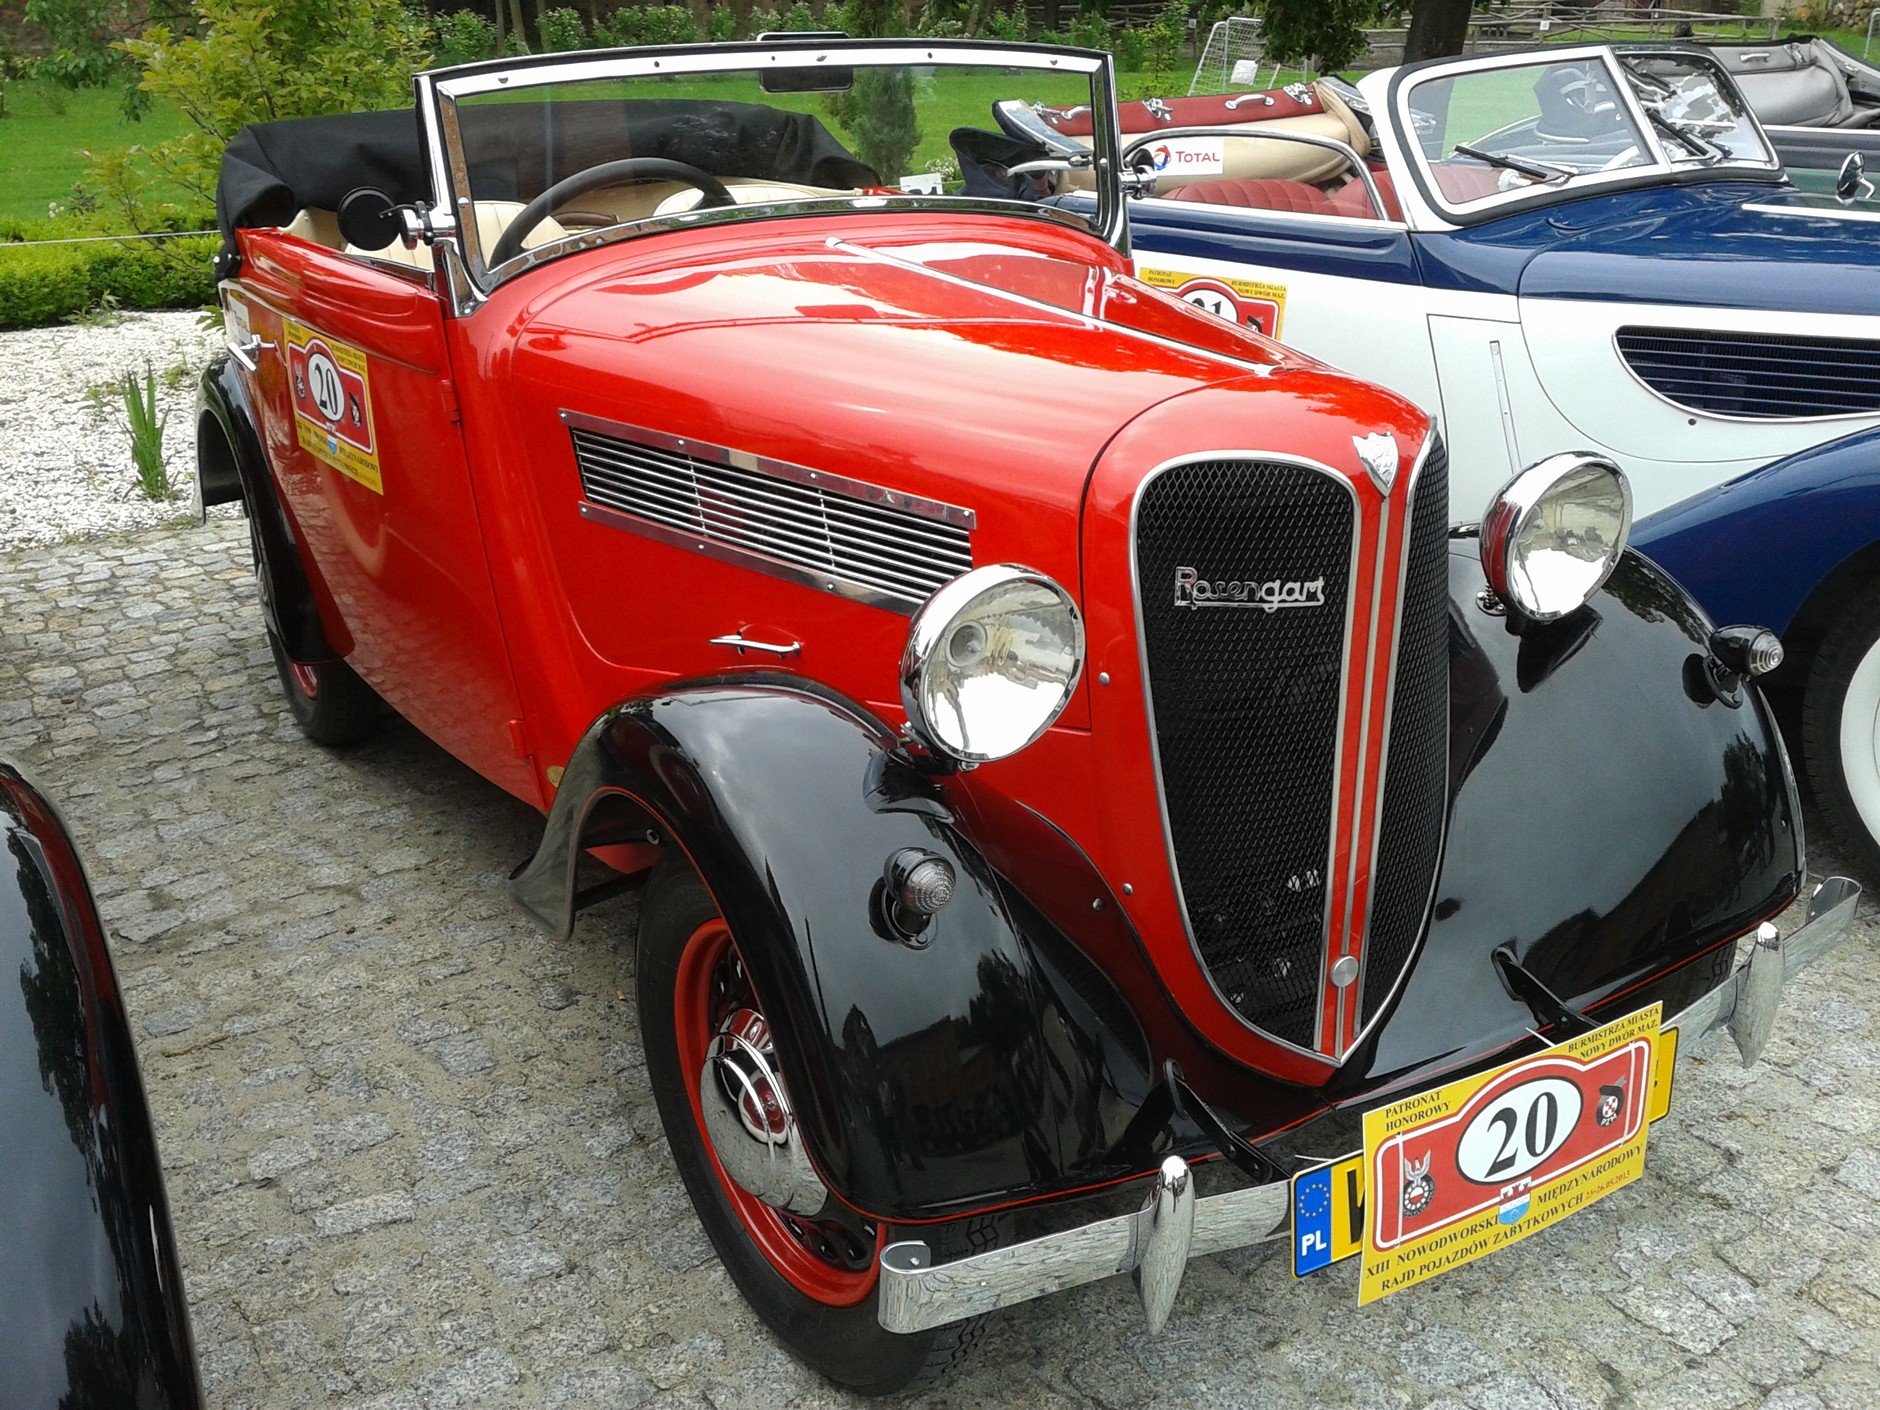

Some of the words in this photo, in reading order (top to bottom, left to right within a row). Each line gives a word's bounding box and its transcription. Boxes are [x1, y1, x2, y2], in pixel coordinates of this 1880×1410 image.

[314, 362, 338, 416] 20
[1174, 566, 1325, 613] Rosengart
[1567, 1023, 1626, 1053] BURMISTRZA
[1627, 1007, 1660, 1027] MIASTA
[1580, 1040, 1609, 1059] NOWY
[1608, 1029, 1635, 1047] DWÓR
[1385, 1090, 1442, 1119] PATRONAT
[1385, 1101, 1451, 1132] HONOROWY
[1483, 1090, 1559, 1179] 20
[1366, 1259, 1390, 1279] XIII
[1397, 1213, 1500, 1266] NOWODWORSKI
[1536, 1142, 1644, 1207] MIĘDZYNARODOWY
[1301, 1230, 1327, 1257] PL
[1381, 1269, 1416, 1292] RAJD
[1419, 1236, 1491, 1276] POJAZDÓW
[1493, 1193, 1585, 1246] ZABYTKOWYCH
